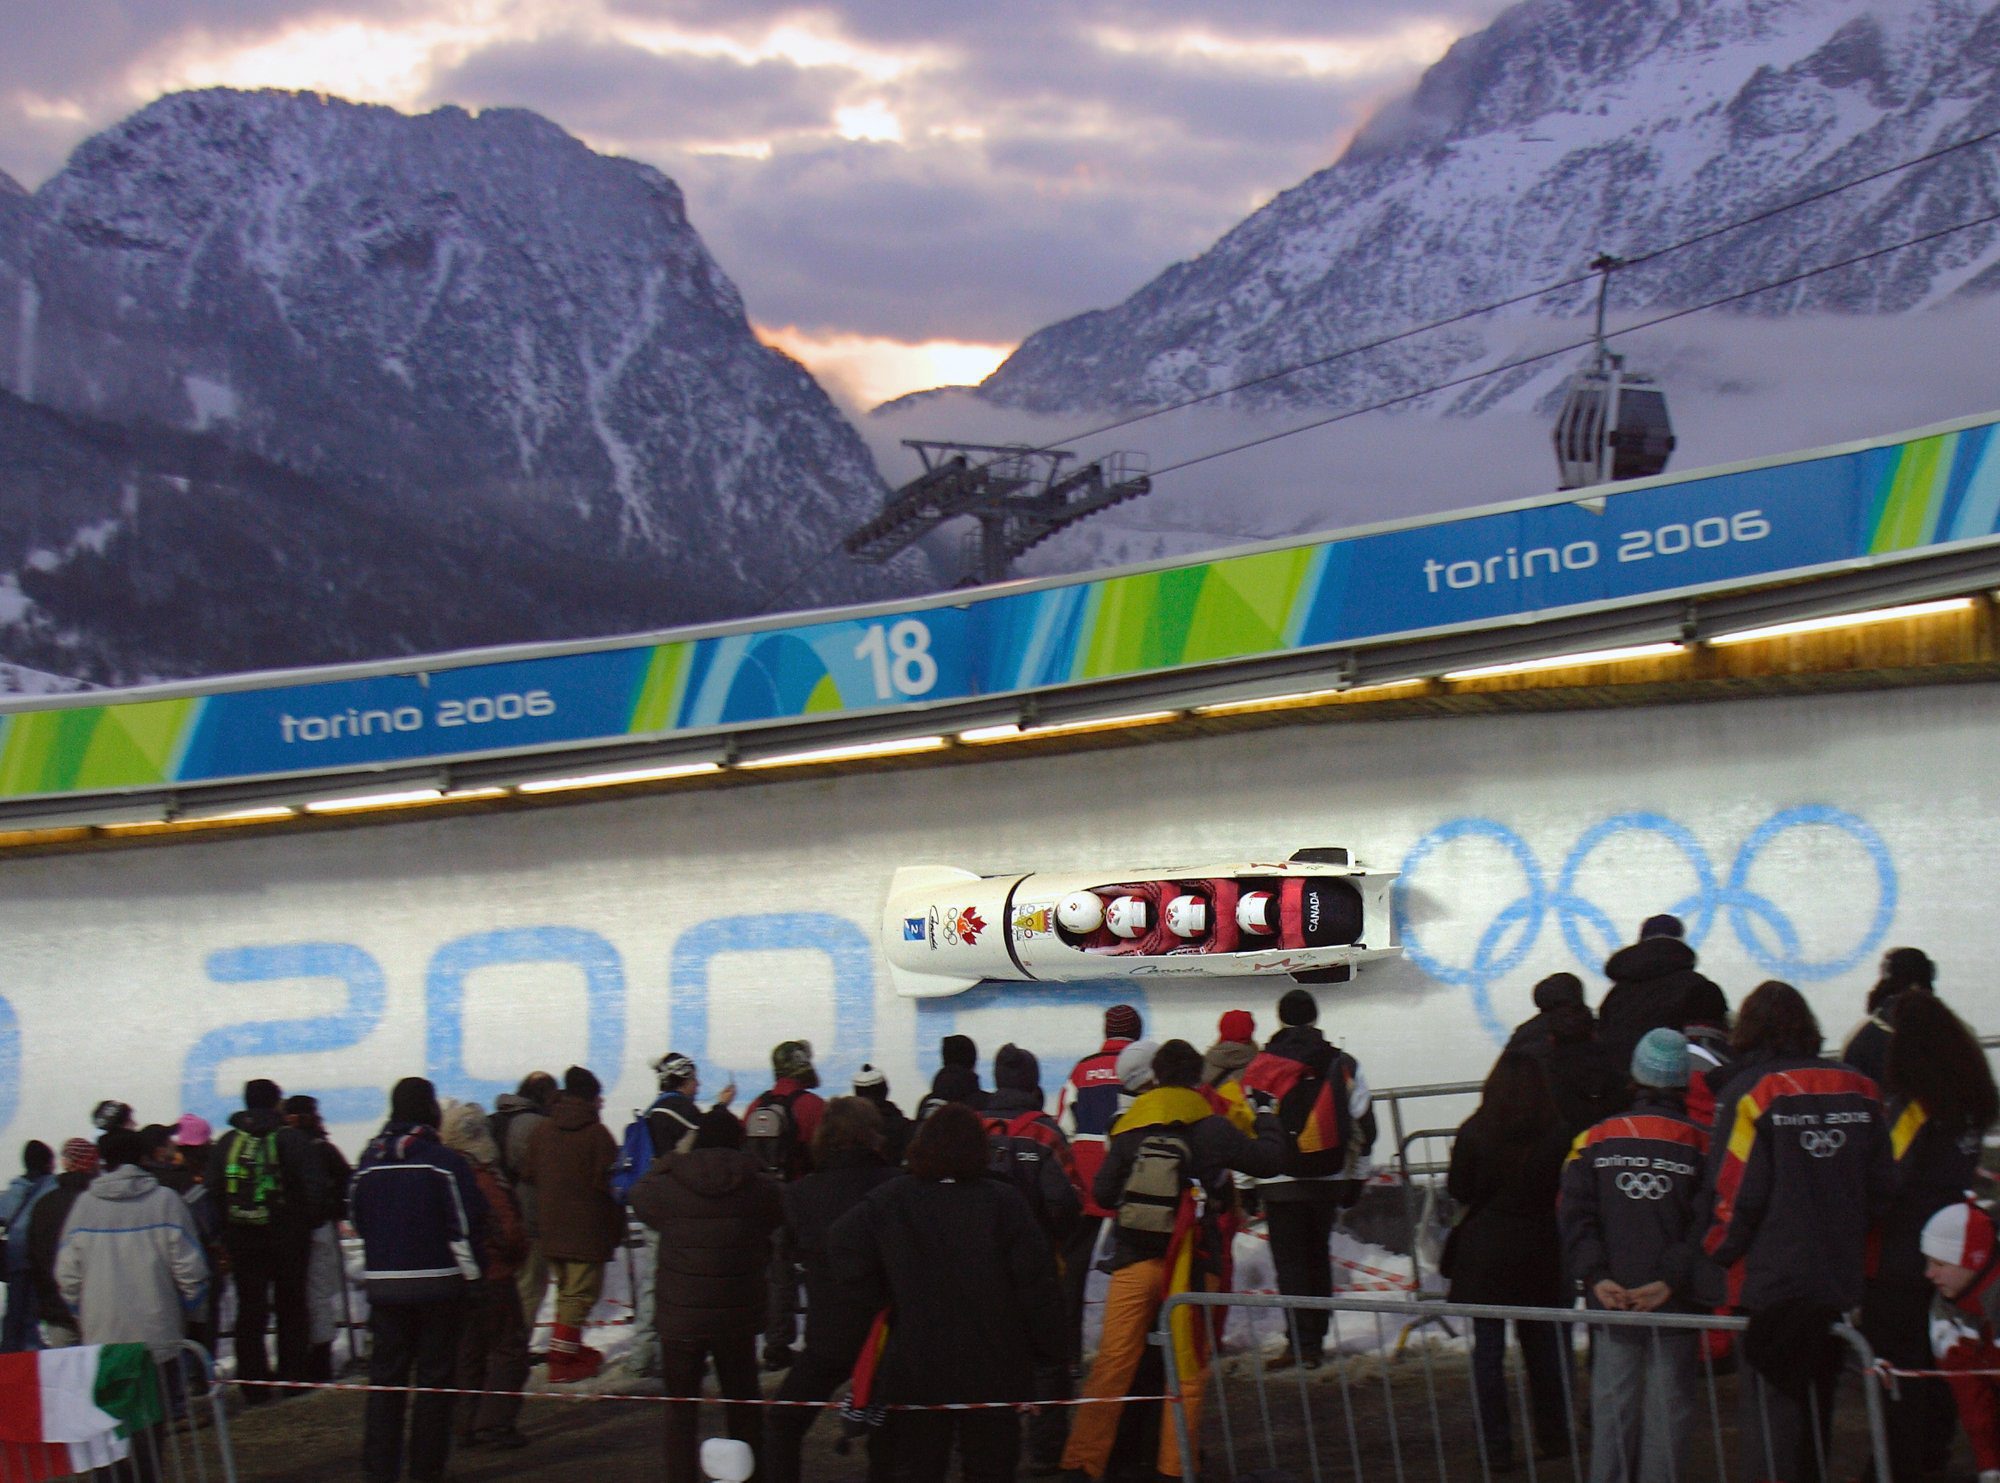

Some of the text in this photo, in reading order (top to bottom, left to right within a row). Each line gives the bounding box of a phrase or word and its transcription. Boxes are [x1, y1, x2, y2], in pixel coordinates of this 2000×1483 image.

[1423, 509, 1771, 593] torino 2006
[854, 619, 939, 700] 18
[280, 690, 557, 744] torino 2006
[910, 924, 919, 934] 2
[1308, 891, 1320, 932] CANADA
[1129, 965, 1205, 975] Canada
[1593, 1154, 1650, 1168] orino
